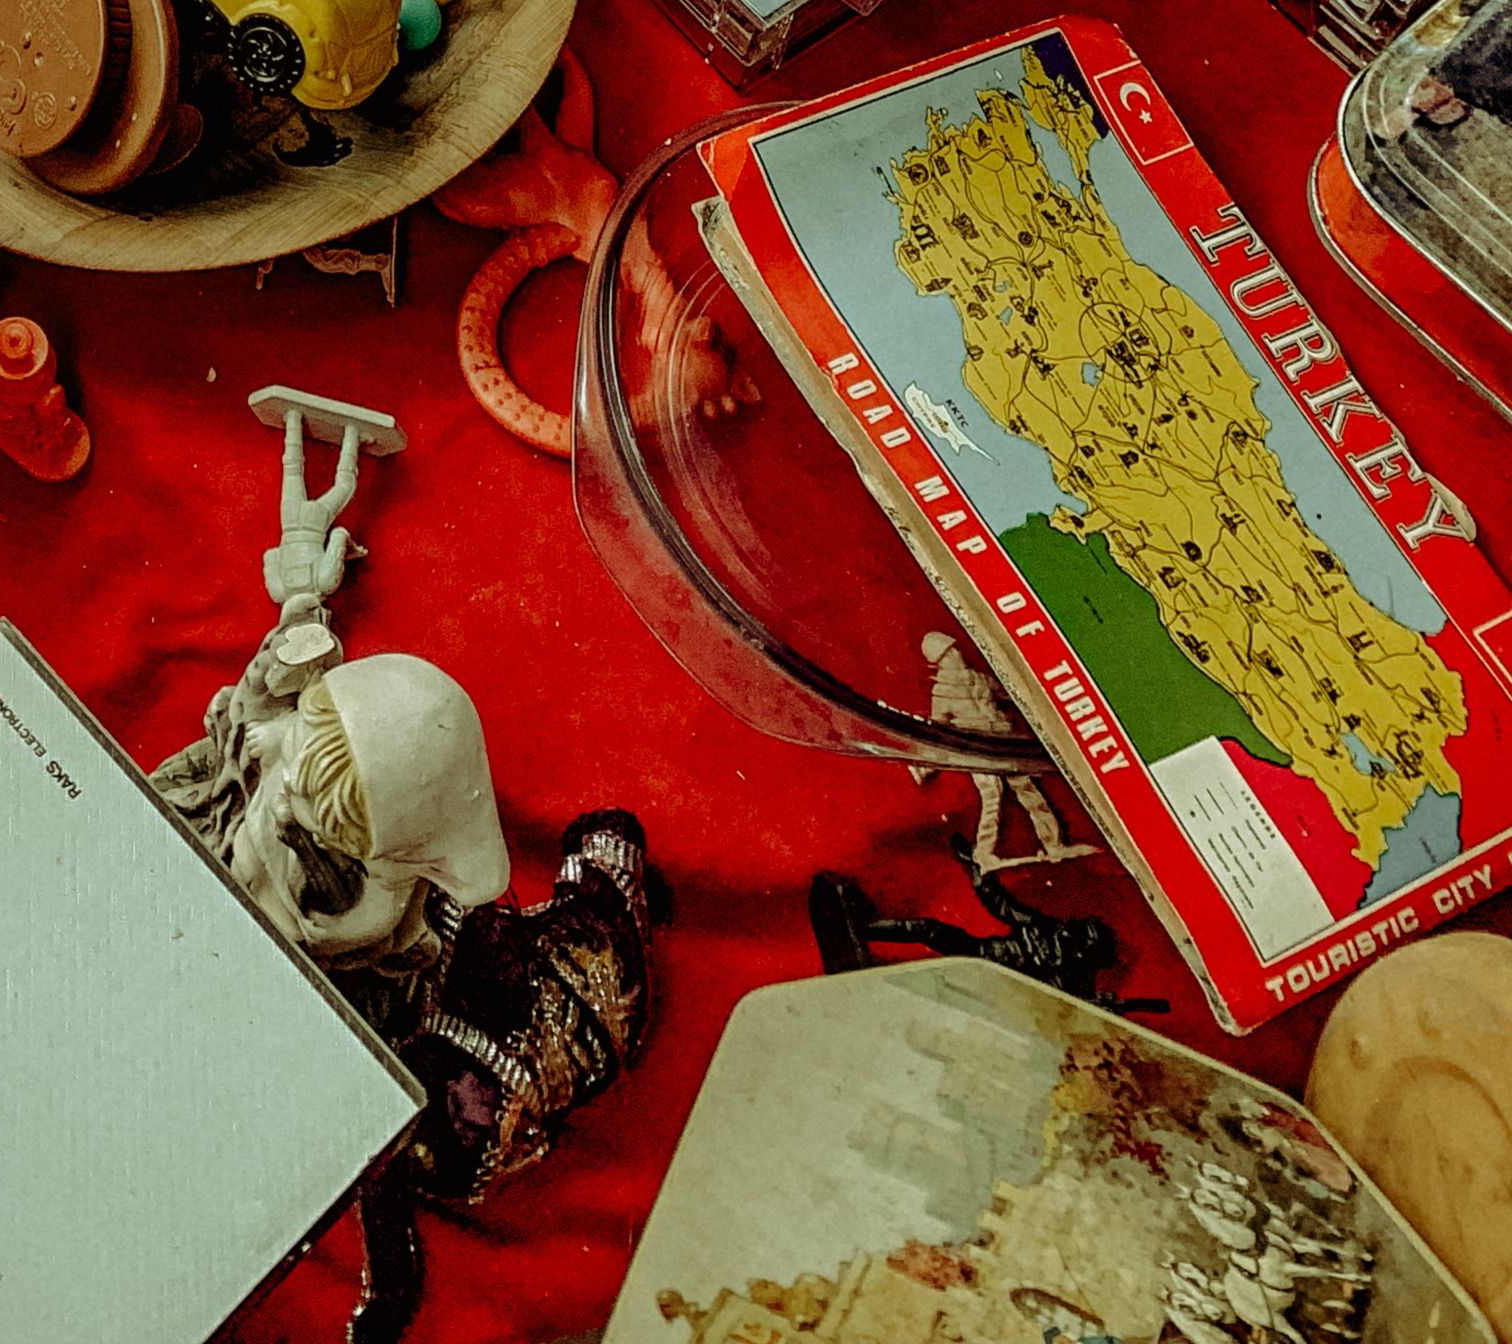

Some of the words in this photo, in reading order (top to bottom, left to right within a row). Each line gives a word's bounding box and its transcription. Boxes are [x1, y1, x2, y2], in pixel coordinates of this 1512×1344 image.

[944, 396, 970, 430] KKTC
[1188, 201, 1477, 553] TURKEY
[827, 353, 911, 450] ROAD
[913, 473, 987, 561] MAP
[993, 589, 1043, 641] OF
[1040, 654, 1129, 780] TURKEY
[43, 758, 82, 801] RAKS
[1265, 905, 1421, 1003] TOURISTIC
[1431, 863, 1495, 915] CITY
